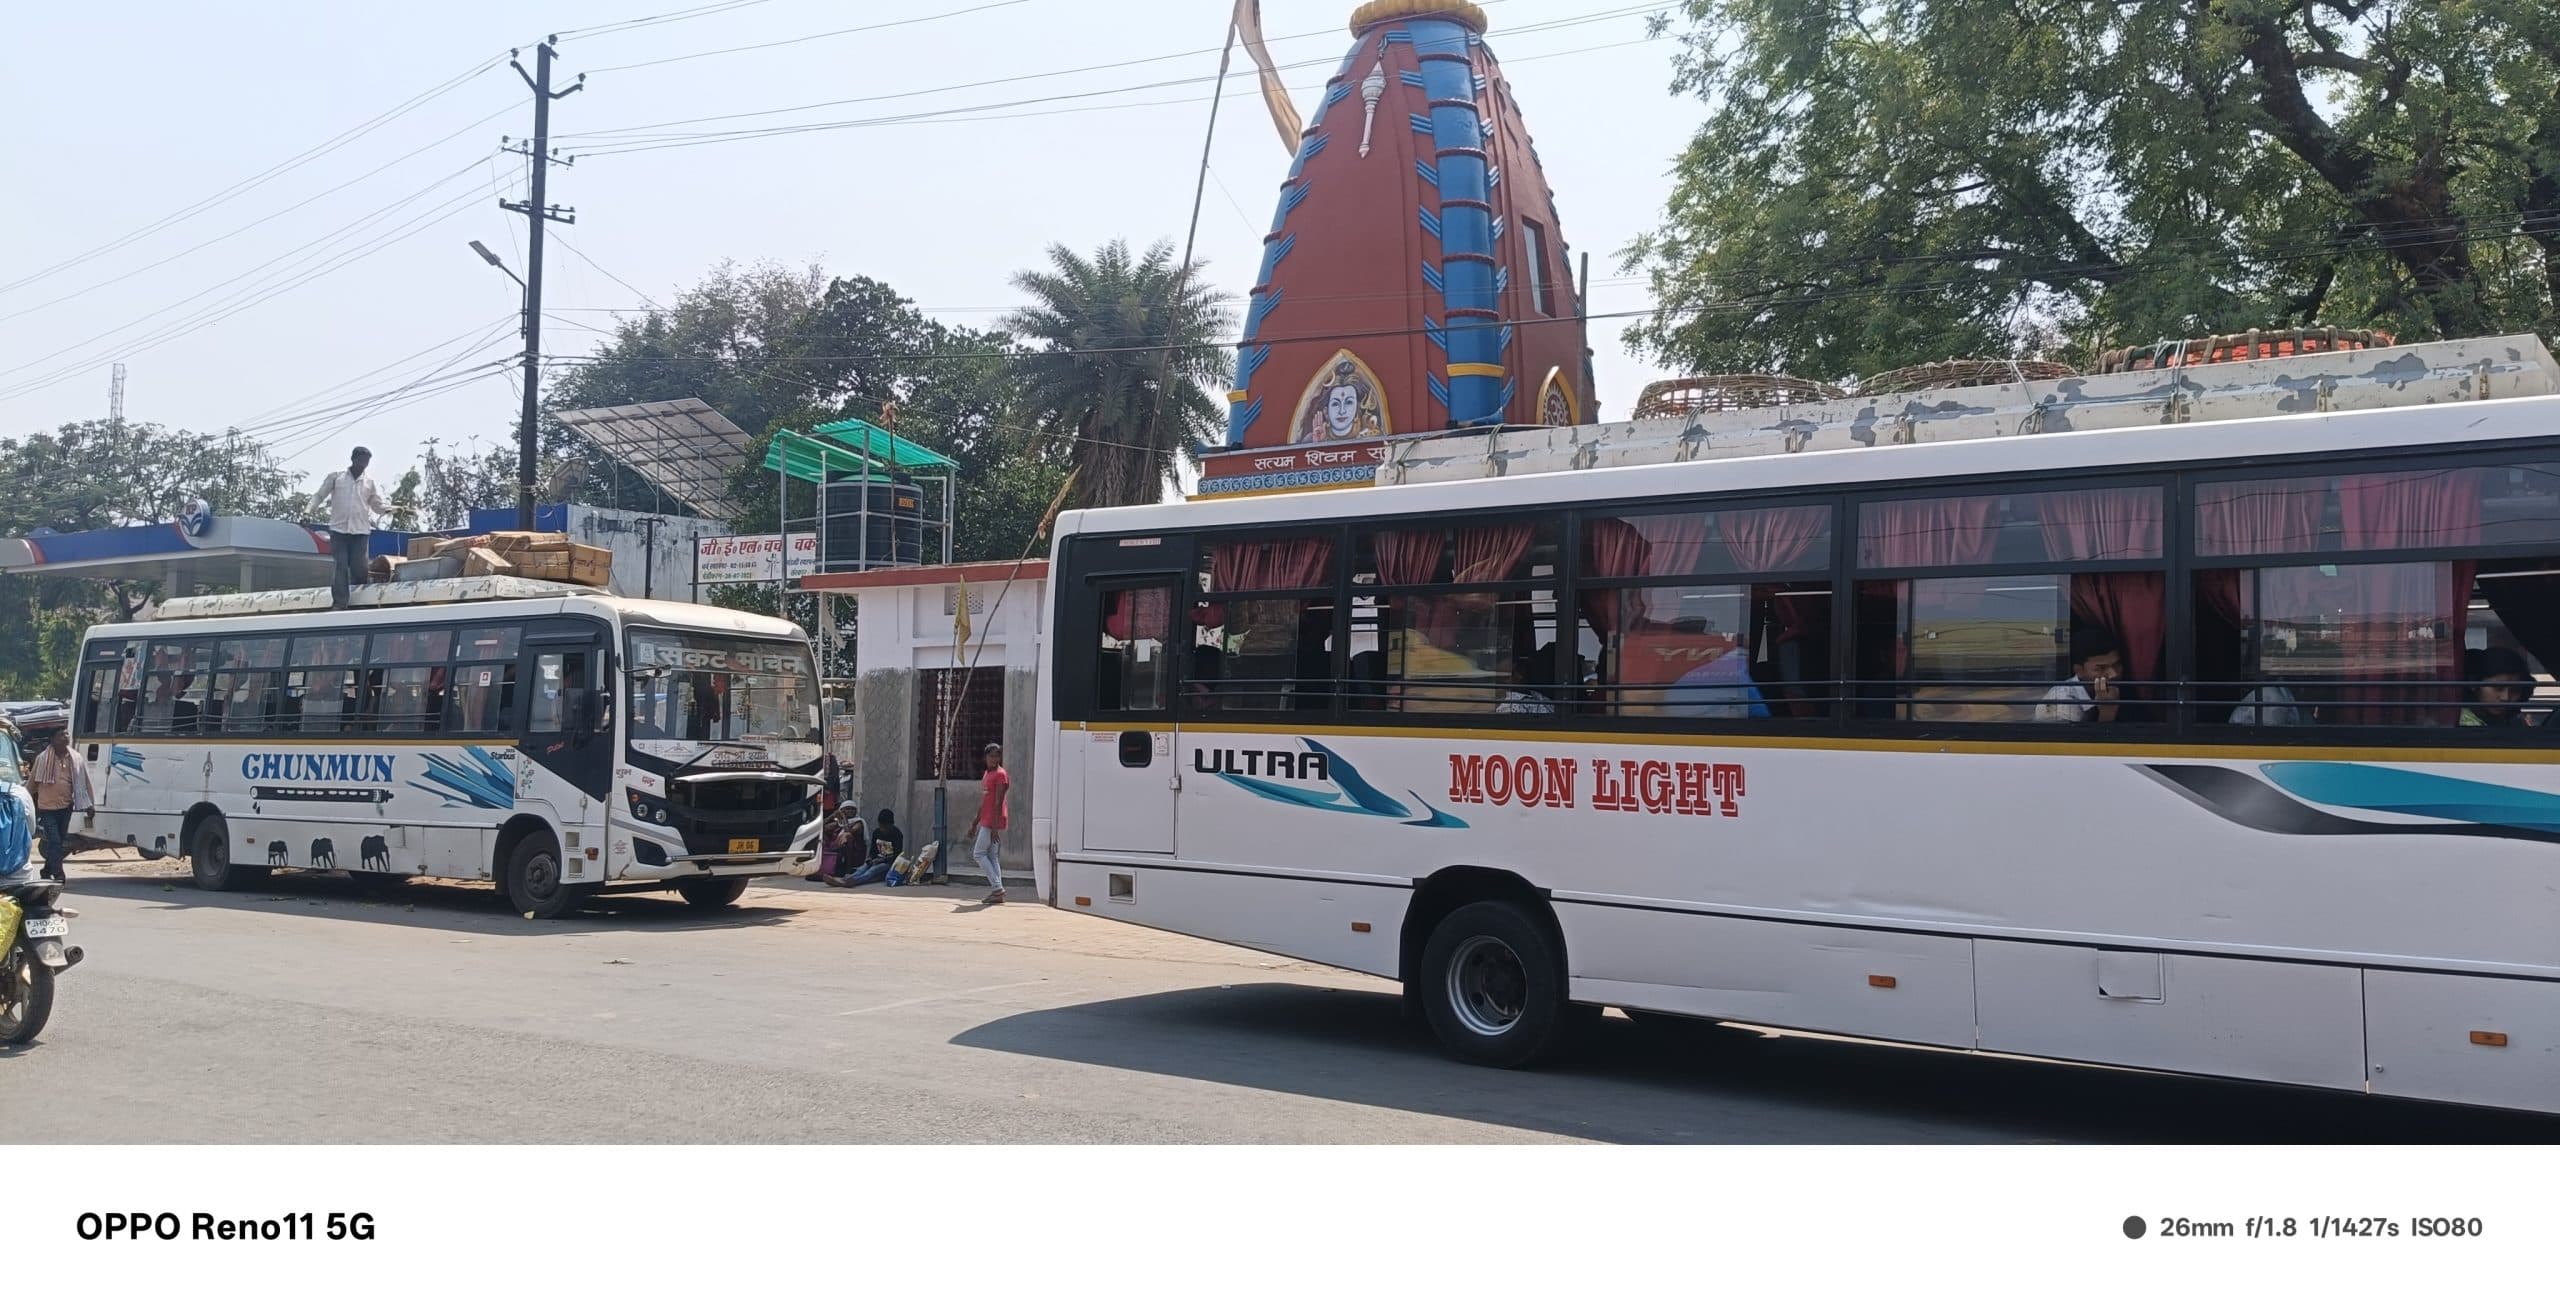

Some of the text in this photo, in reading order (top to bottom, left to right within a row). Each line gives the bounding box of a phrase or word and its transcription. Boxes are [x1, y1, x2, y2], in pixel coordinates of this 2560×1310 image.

[242, 753, 396, 783] CHUNMUN
[490, 751, 516, 761] Starbus
[1194, 748, 1329, 781] ULTRA
[1449, 754, 1745, 818] MOON LIGHT
